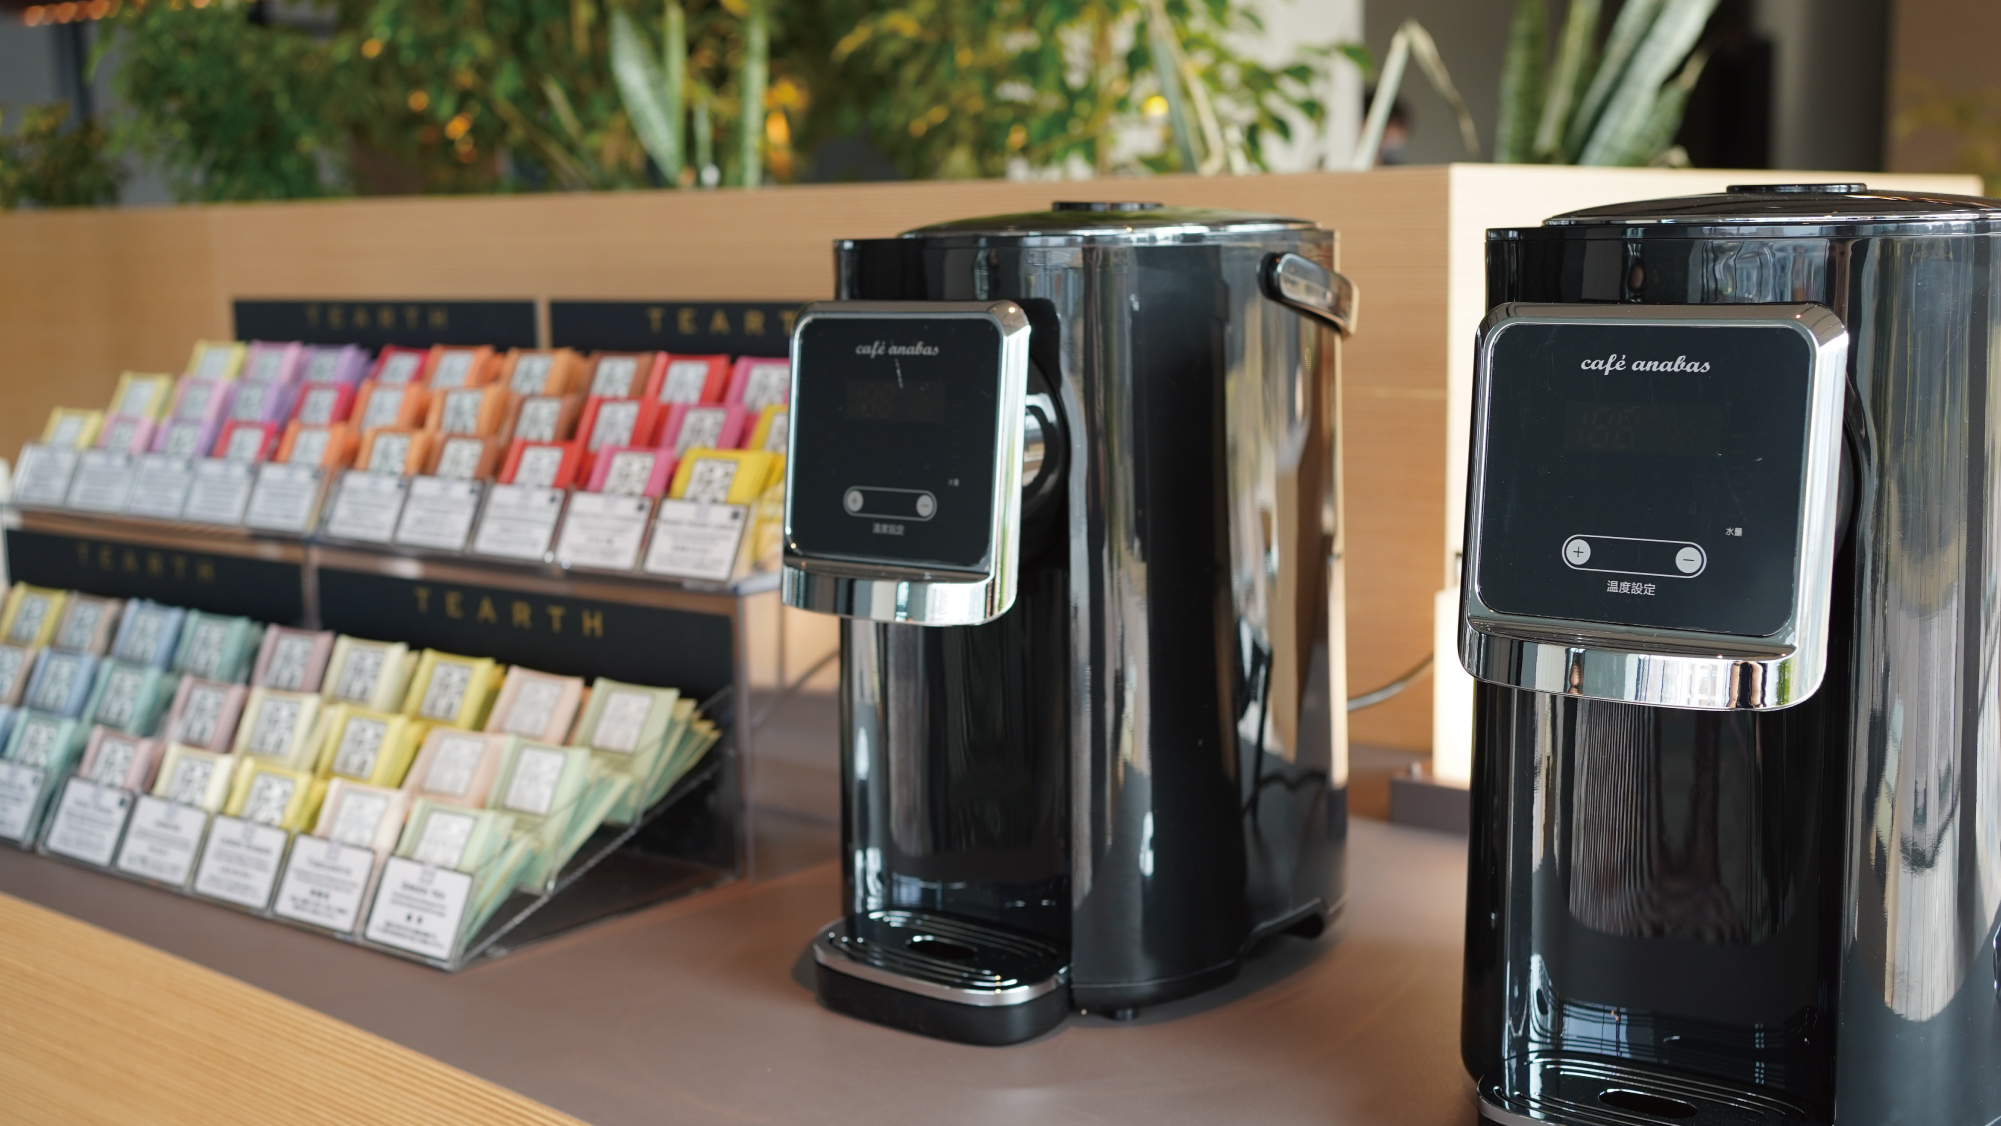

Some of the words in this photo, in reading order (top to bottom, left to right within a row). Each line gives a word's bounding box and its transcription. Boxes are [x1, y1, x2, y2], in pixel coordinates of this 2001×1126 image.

[646, 308, 796, 336] TEART
[855, 340, 886, 359] café
[888, 341, 939, 356] anabas
[1580, 353, 1627, 376] café
[1631, 355, 1711, 373] anabas
[1606, 579, 1656, 596] 温度設定
[412, 586, 604, 639] TEARTH
